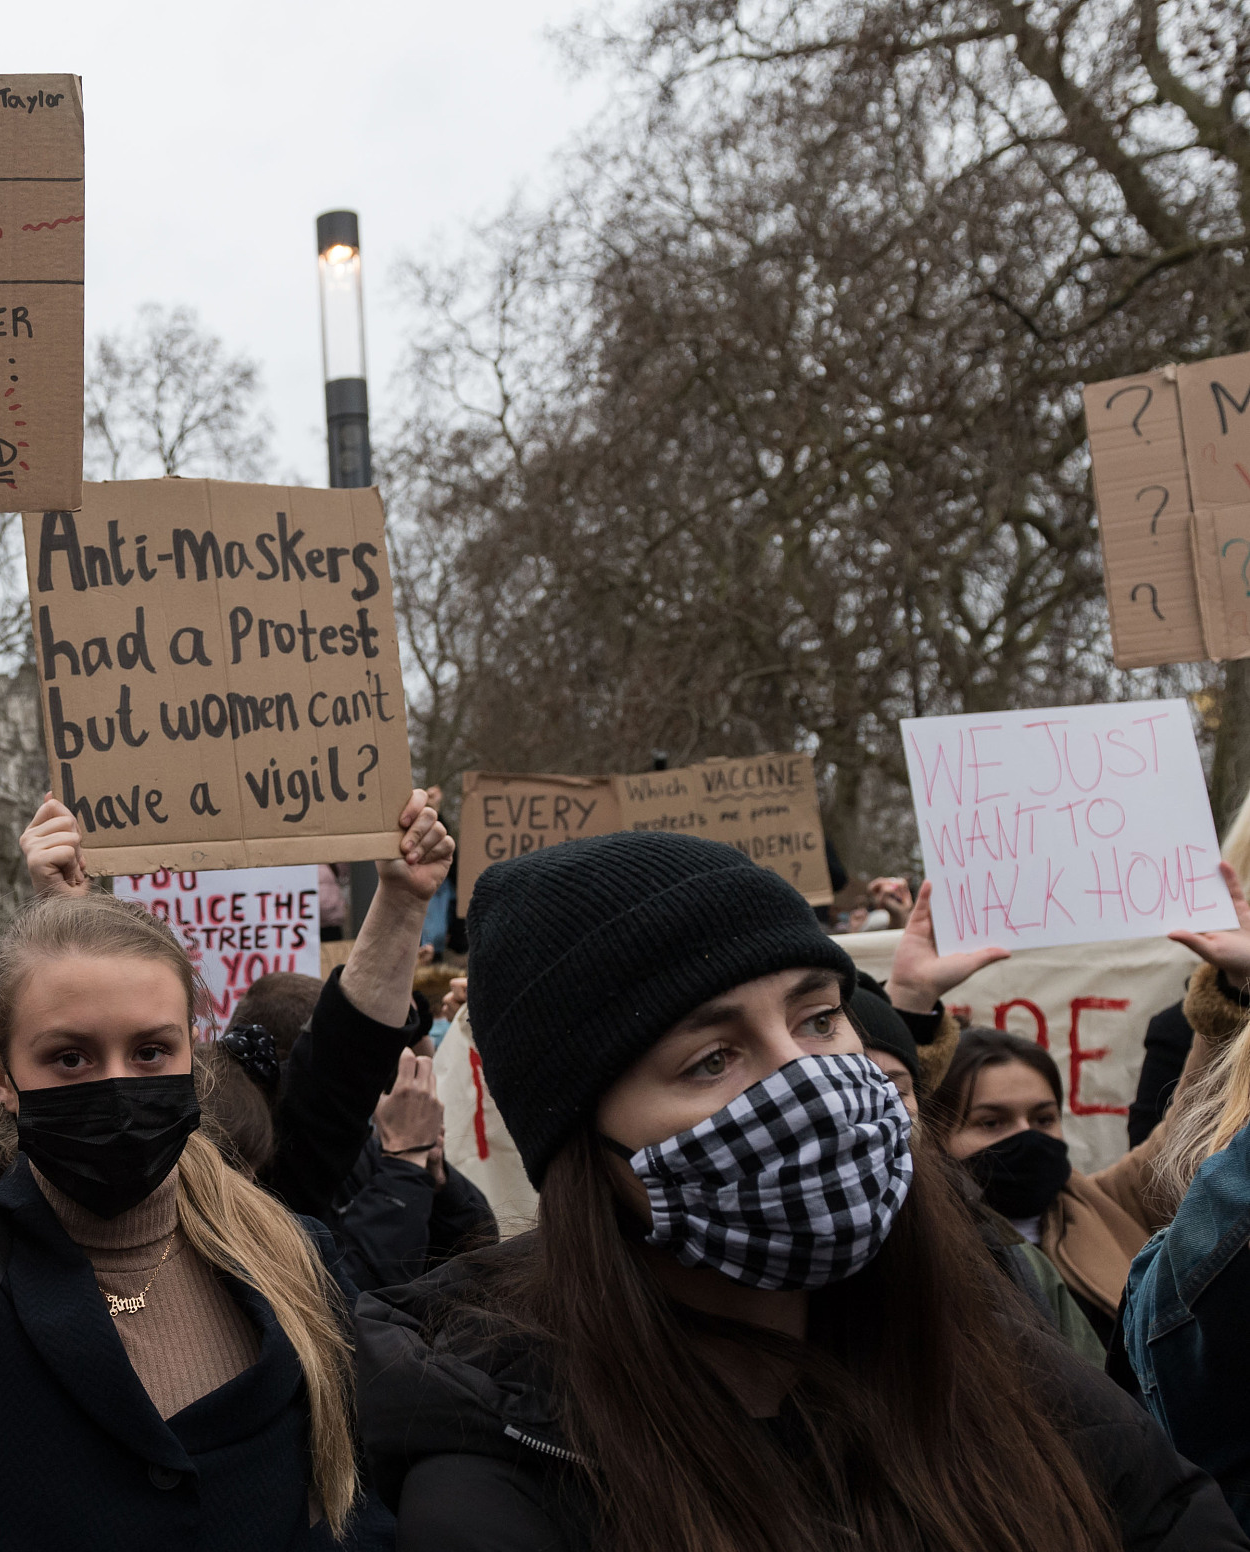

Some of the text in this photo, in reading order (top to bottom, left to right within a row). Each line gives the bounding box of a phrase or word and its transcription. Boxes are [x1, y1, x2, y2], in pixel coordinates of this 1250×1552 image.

[38, 605, 157, 681] had
[169, 626, 213, 667] a
[48, 670, 395, 760] but women can't
[702, 758, 804, 793] VACCINE
[910, 713, 1169, 807] WE JUST
[60, 743, 380, 833] have a vigil?
[483, 795, 597, 832] EVERY
[727, 831, 817, 860] NDEMIC
[926, 797, 1126, 868] WANT TO
[255, 890, 317, 922] THE
[946, 845, 1217, 941] WALK HOME
[182, 922, 308, 951] STREETS
[107, 1292, 147, 1317] Angel
